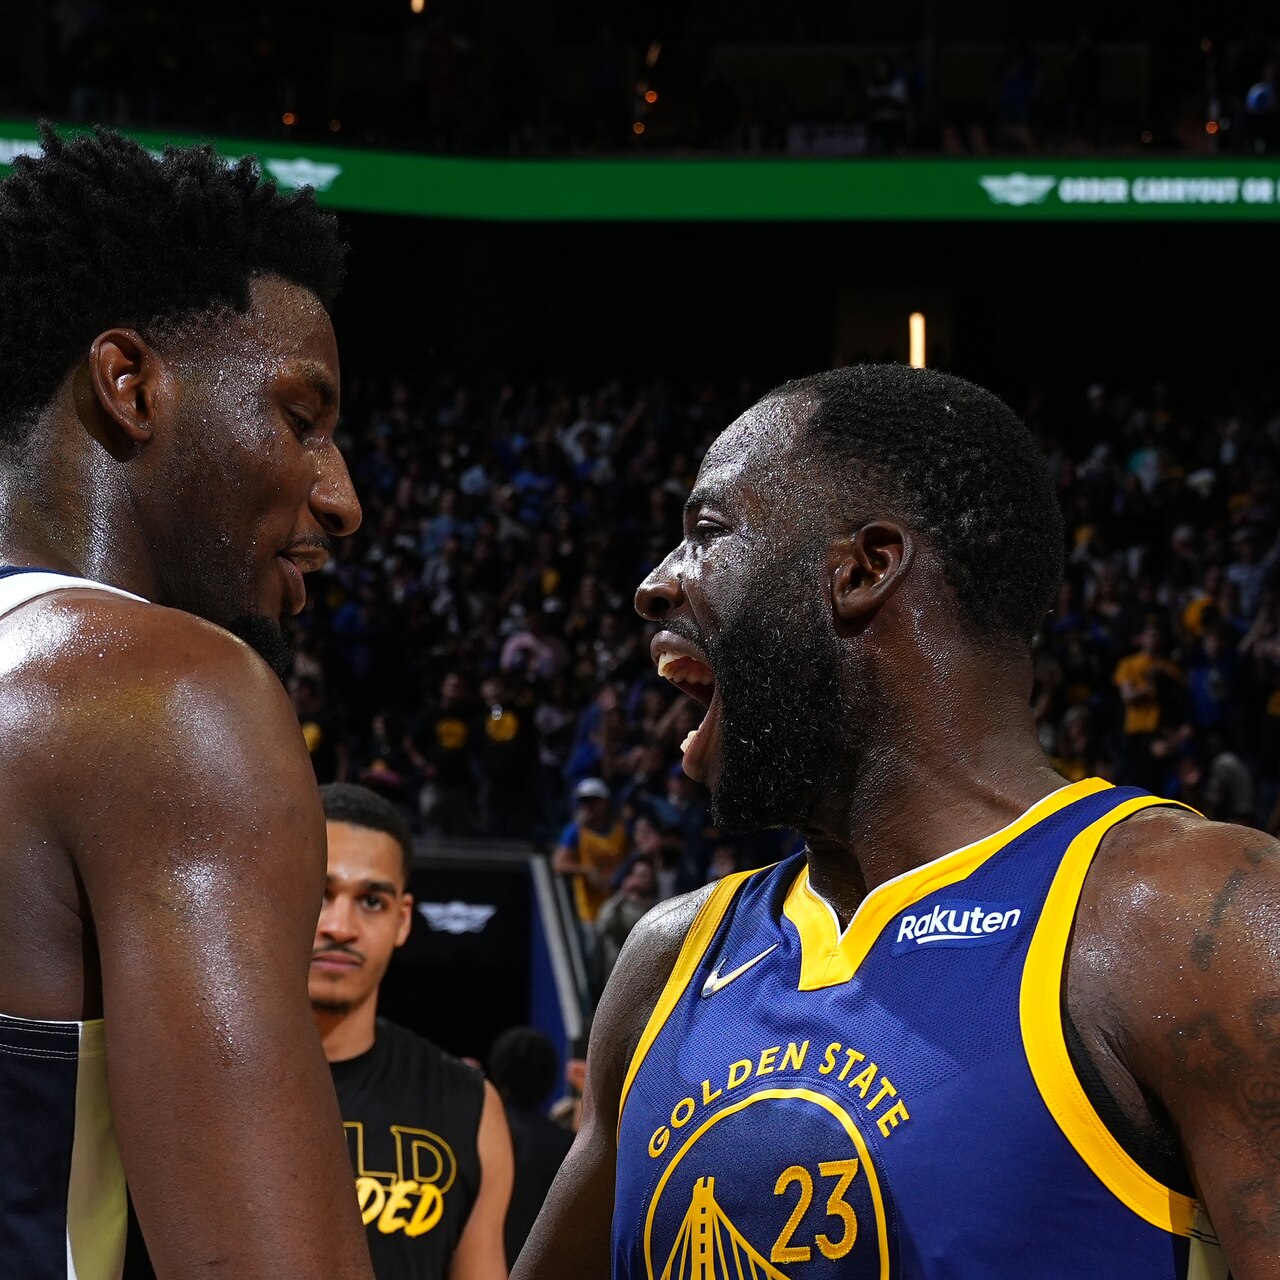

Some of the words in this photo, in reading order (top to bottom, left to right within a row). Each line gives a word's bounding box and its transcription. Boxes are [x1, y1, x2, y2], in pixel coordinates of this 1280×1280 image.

[1058, 175, 1129, 203] ORDER
[1241, 175, 1275, 203] OR
[896, 904, 1021, 944] Rakuten
[648, 1039, 809, 1159] GOLDEN
[818, 1040, 911, 1139] STATE
[770, 1157, 858, 1264] 23
